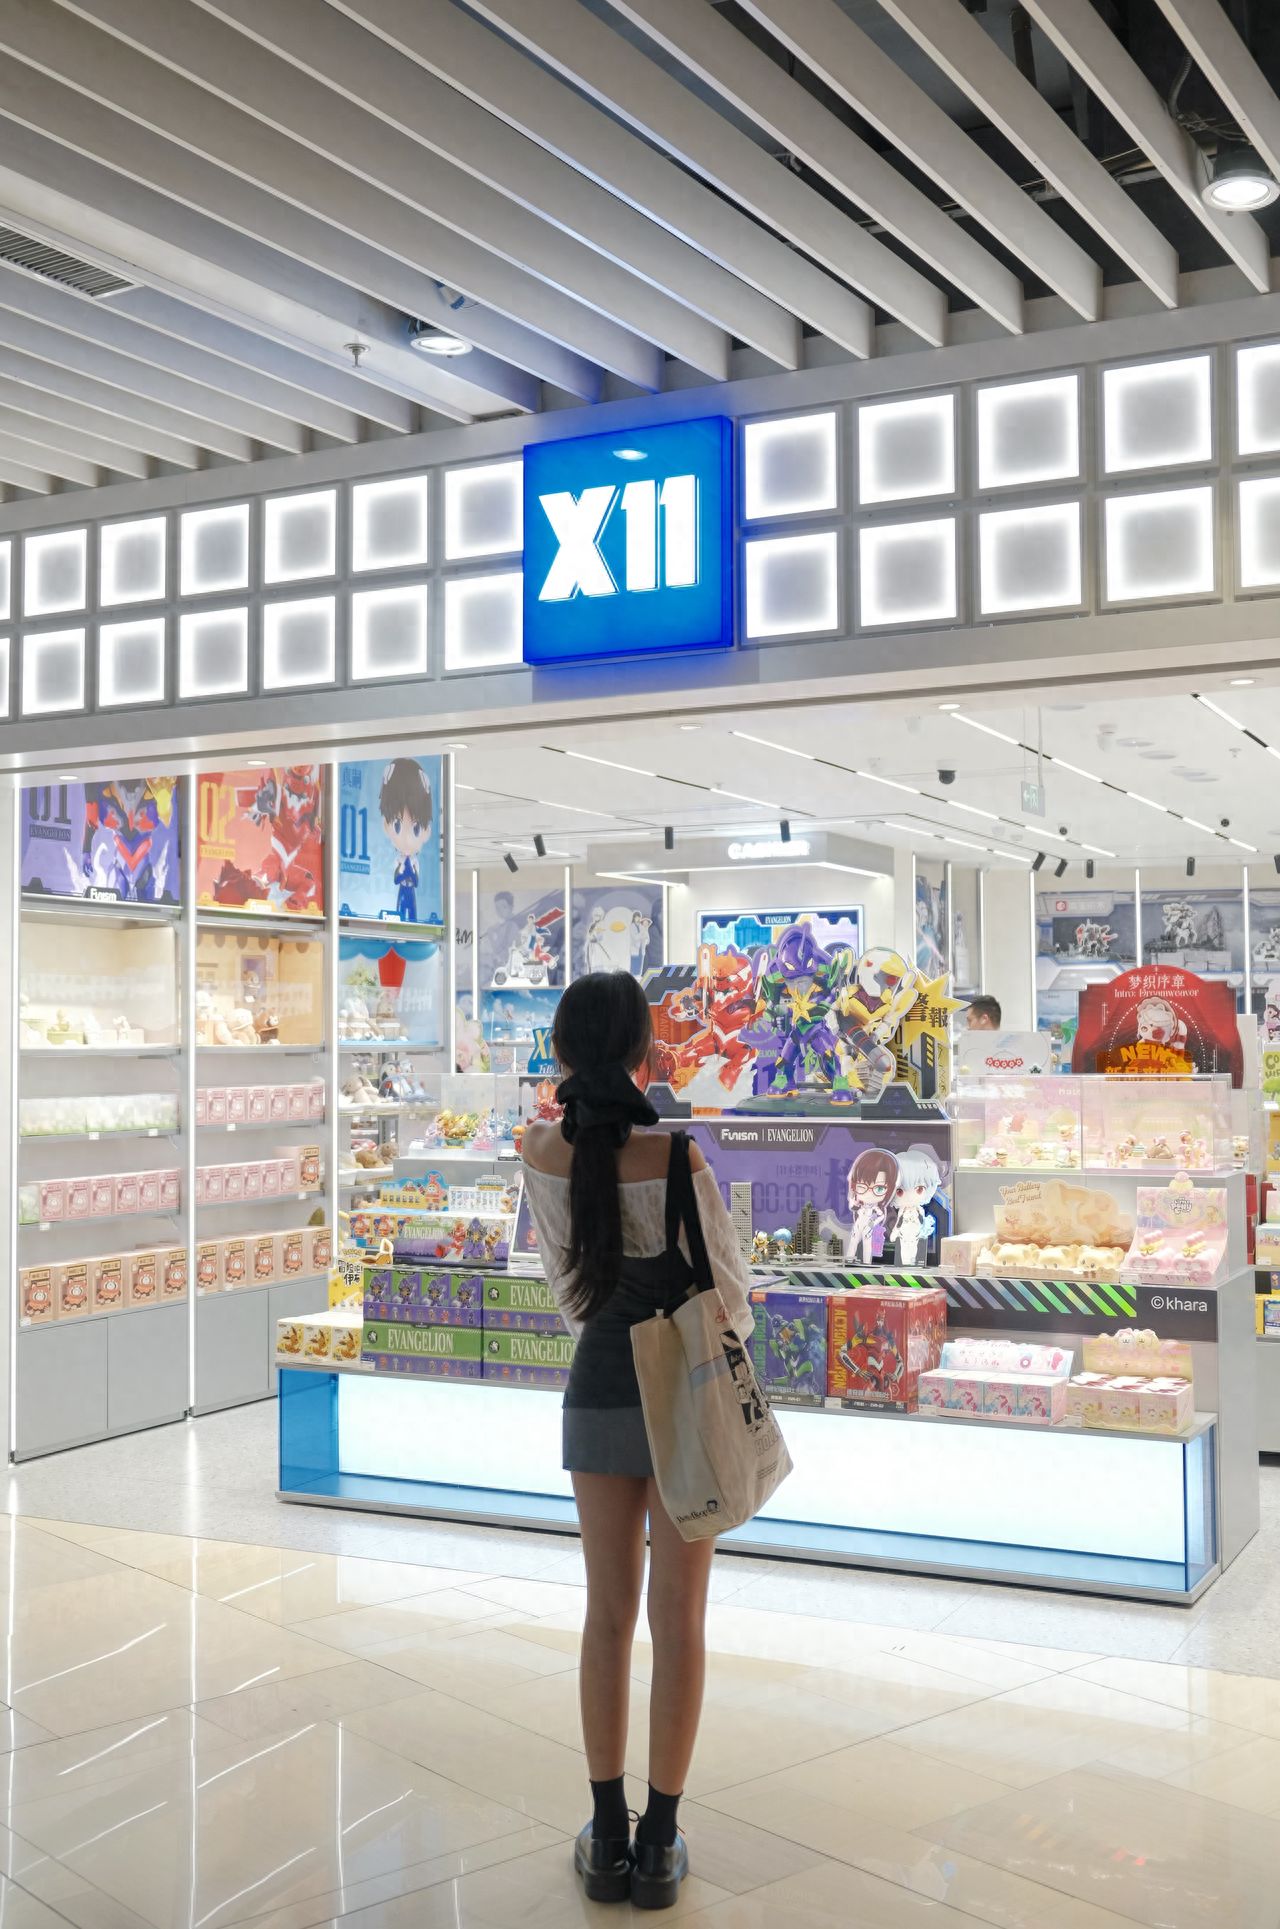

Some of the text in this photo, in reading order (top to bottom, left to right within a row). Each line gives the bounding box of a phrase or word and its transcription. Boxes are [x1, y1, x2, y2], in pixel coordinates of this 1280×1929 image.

[538, 474, 700, 602] X11
[200, 781, 236, 845] 02
[340, 803, 371, 861] 01
[1128, 974, 1186, 990] 梦织序章
[720, 1128, 814, 1142] Funism EVANGELION
[388, 1328, 454, 1354] EVANGELION
